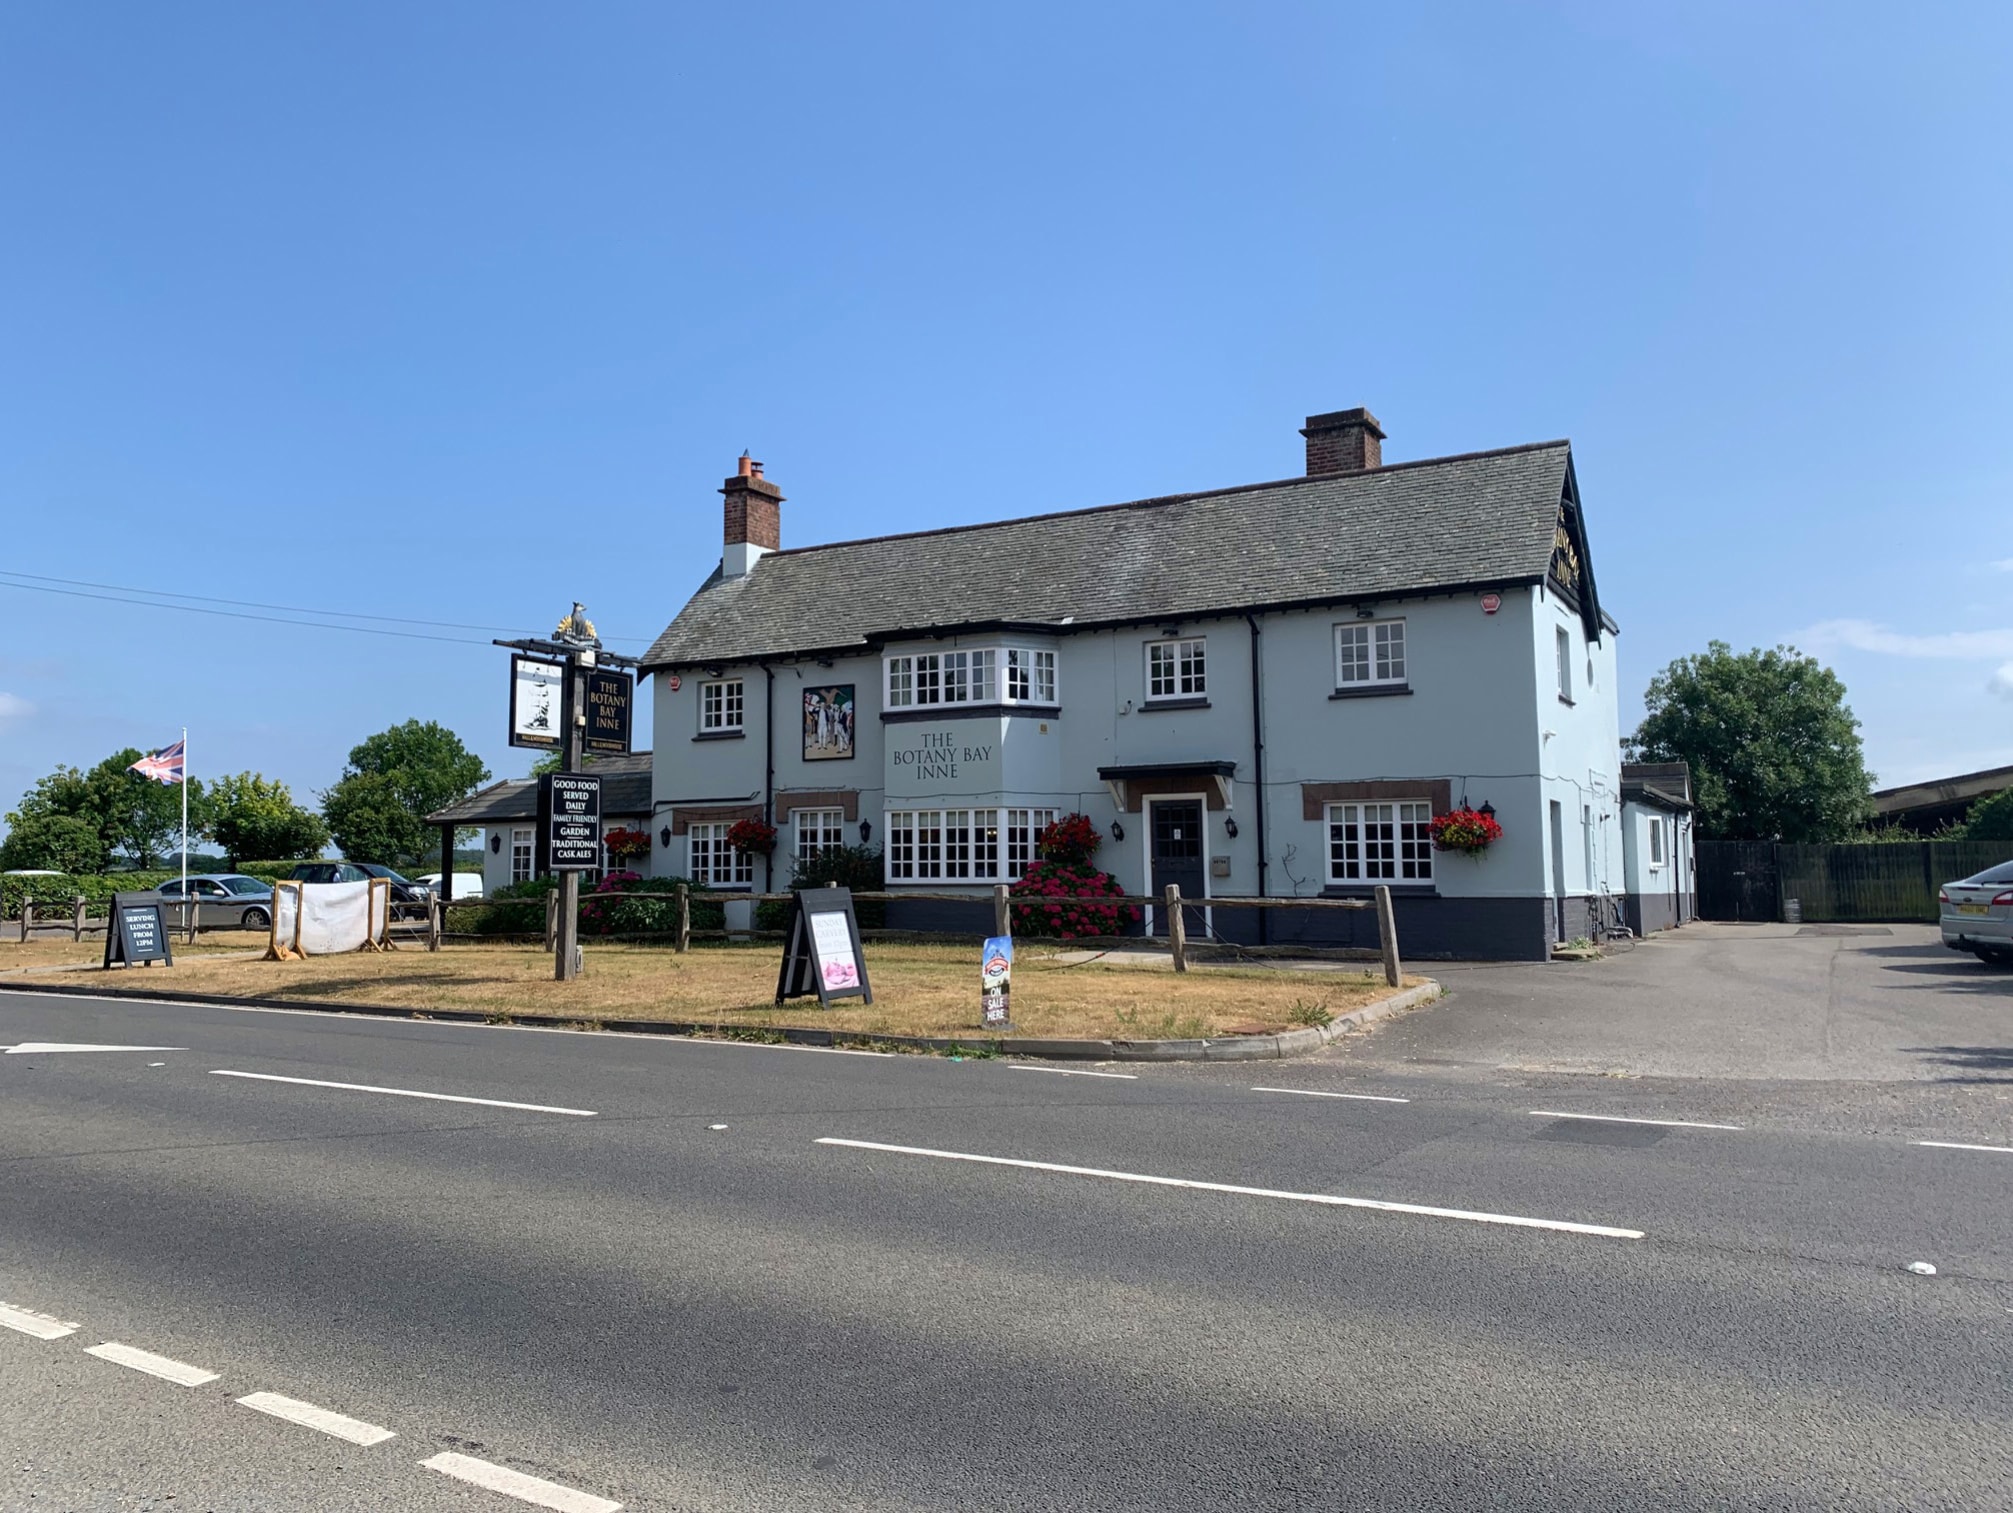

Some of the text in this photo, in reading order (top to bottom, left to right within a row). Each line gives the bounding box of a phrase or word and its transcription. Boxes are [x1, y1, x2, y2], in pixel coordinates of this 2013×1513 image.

[600, 682, 618, 694] THE
[590, 692, 627, 707] BOTANY
[600, 706, 616, 717] BAY
[596, 718, 620, 730] INNE
[921, 732, 953, 748] THE
[894, 746, 992, 765] BOTANY BAY
[917, 764, 958, 780] INNE
[554, 780, 598, 790] GOOD FOOD
[563, 791, 589, 800] SERVED
[566, 801, 586, 810] DAILY
[553, 814, 597, 823] FAMILY FRIENDLY
[560, 827, 590, 836] GARDEN
[552, 840, 598, 848] TRADITIONAL
[557, 850, 592, 858] CASK ALES
[126, 914, 155, 922] SERVING
[990, 986, 1002, 997] ON
[988, 998, 1004, 1010] SALE
[987, 1009, 1004, 1021] HERE
